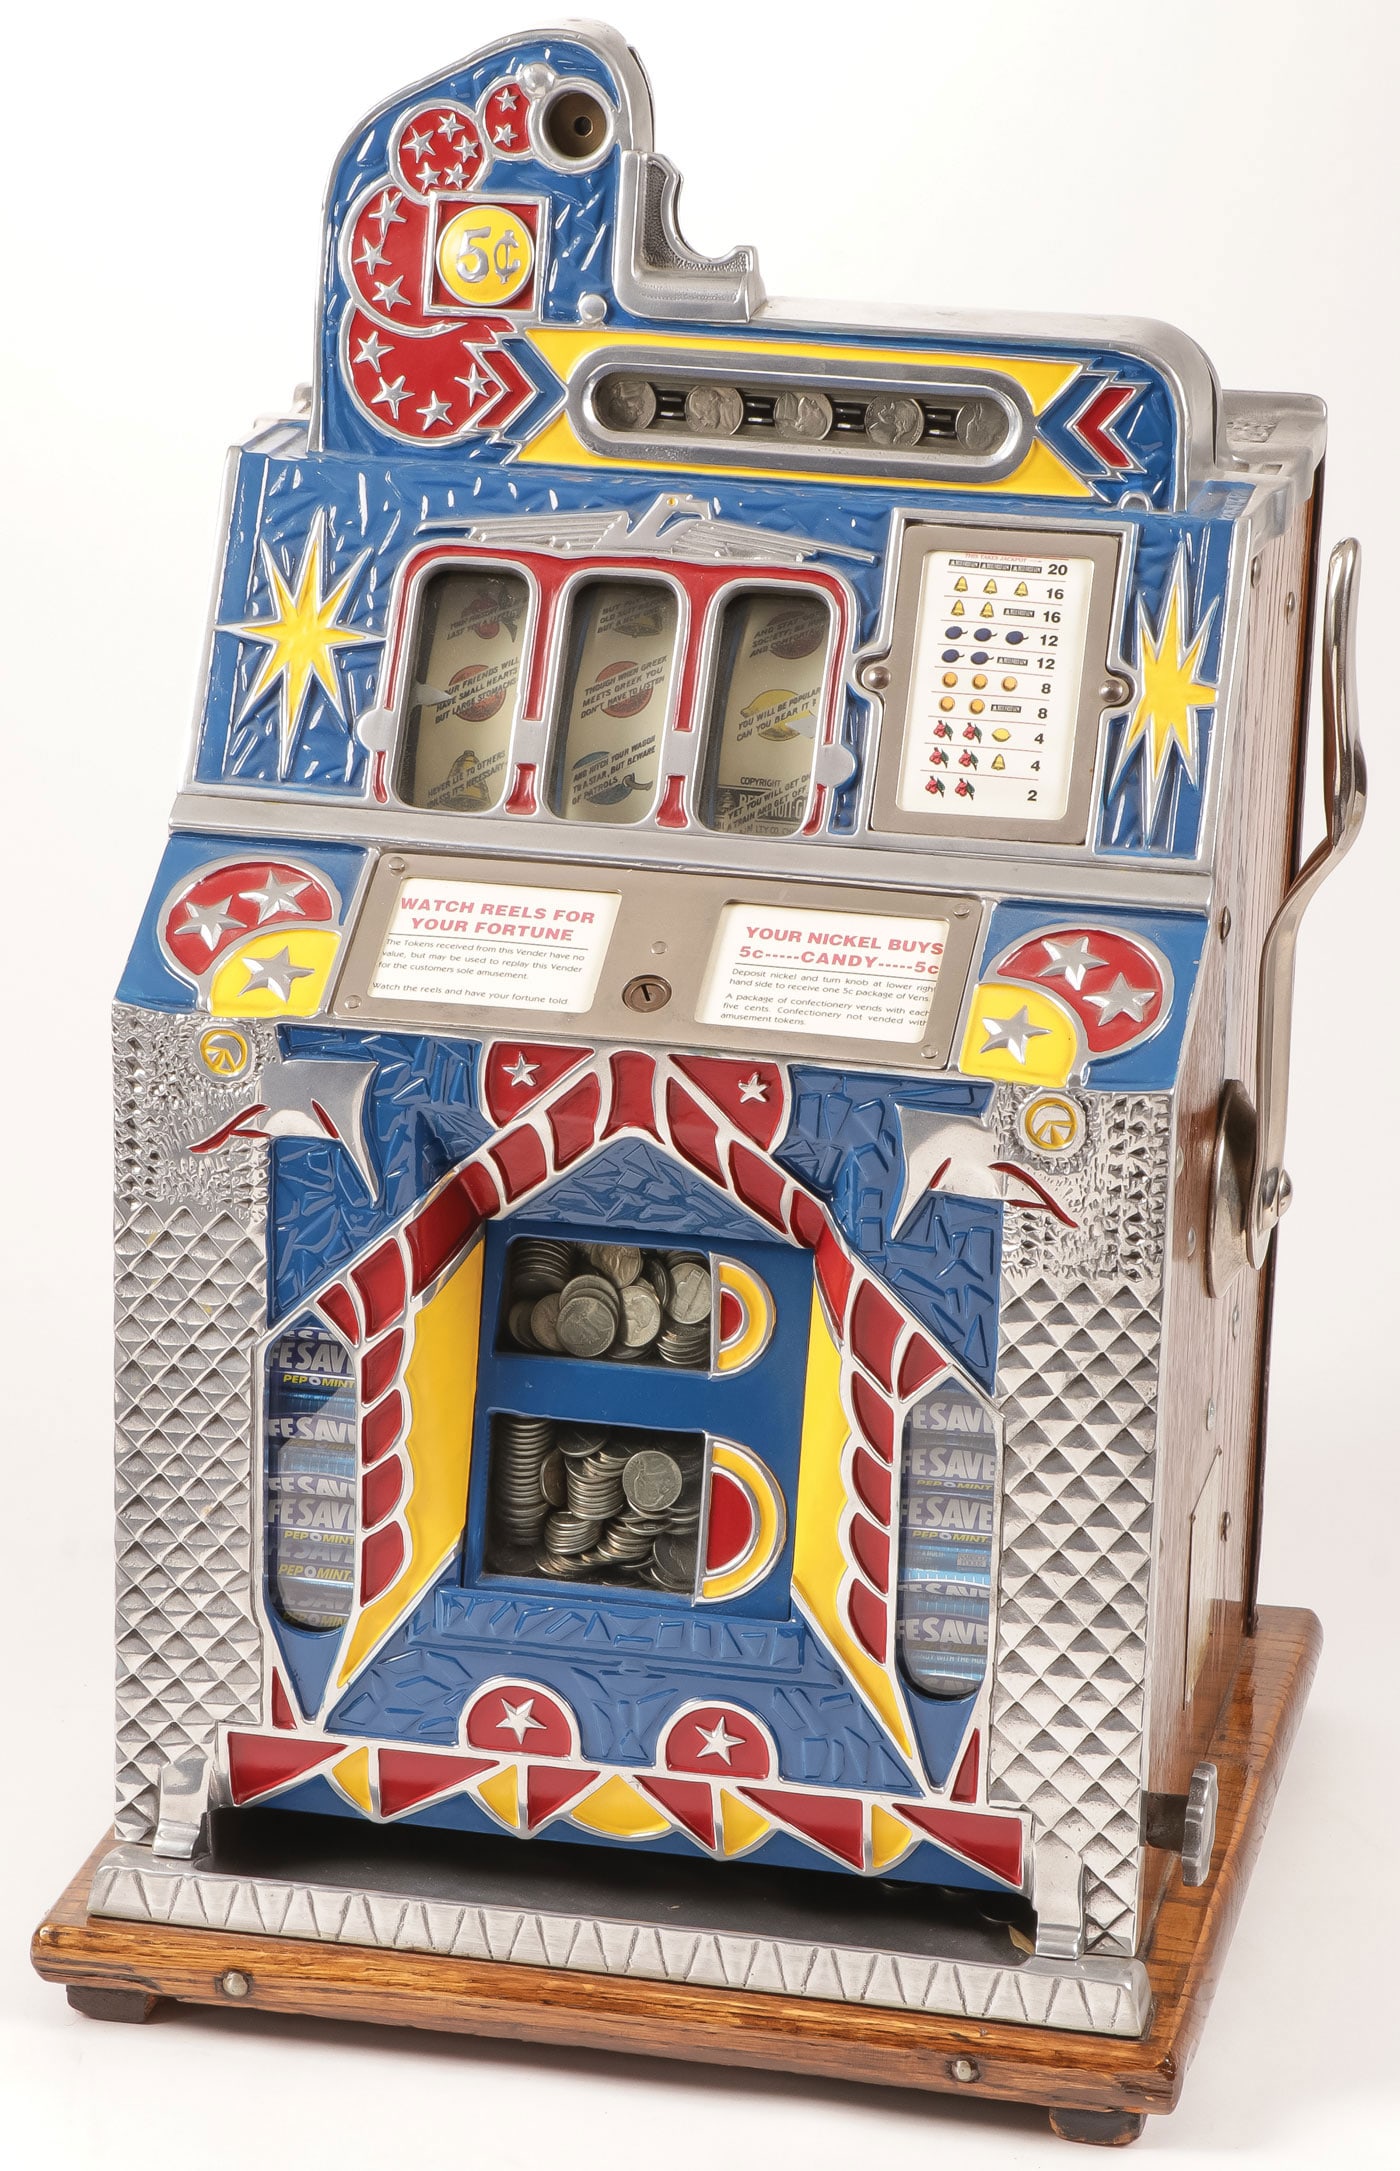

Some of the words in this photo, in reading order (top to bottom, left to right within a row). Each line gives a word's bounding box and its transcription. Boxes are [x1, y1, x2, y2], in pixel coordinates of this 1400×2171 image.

[456, 226, 521, 285] 5¢
[1047, 564, 1068, 576] 20
[1046, 588, 1065, 600] 16
[1042, 611, 1062, 623] 16
[754, 627, 774, 639] AND
[1040, 635, 1059, 647] 12
[749, 646, 769, 657] AND
[462, 666, 498, 689] FRIENDS
[501, 656, 520, 669] WILL
[1036, 658, 1056, 670] 12
[584, 677, 616, 696] THOUGH
[618, 667, 639, 681] WHEN
[640, 655, 668, 671] GREEK
[436, 696, 457, 712] HAVE
[458, 683, 484, 700] SMALL
[486, 667, 518, 687] HEARTS
[580, 702, 605, 719] DON'T
[608, 692, 627, 706] HAVE
[629, 687, 638, 697] TO
[639, 675, 665, 692] LISTEN
[582, 689, 611, 708] MEETS
[614, 675, 642, 692] GREEK
[646, 666, 663, 679] YOU
[1041, 683, 1052, 695] 8
[435, 710, 450, 724] BUT
[452, 697, 475, 716] LARGE
[738, 717, 754, 730] YOU
[756, 708, 776, 722] WILL
[777, 701, 788, 712] BE
[1037, 708, 1048, 719] 8
[736, 728, 753, 742] CAN
[756, 719, 772, 731] YOU
[774, 707, 798, 724] BEAR
[1034, 733, 1045, 745] 4
[466, 767, 476, 777] TO
[477, 749, 506, 771] OTHERS
[610, 761, 625, 774] BUT
[627, 744, 656, 766] BEWARE
[611, 747, 630, 762] YOUR
[1030, 760, 1041, 772] 4
[583, 777, 618, 799] PATROLS
[728, 807, 743, 819] YET
[747, 797, 762, 809] YOU
[764, 788, 783, 800] WILL
[784, 778, 798, 790] GET
[1027, 790, 1038, 801] 2
[774, 794, 790, 807] GET
[400, 897, 475, 914] WATCH
[480, 903, 547, 920] REELS
[553, 909, 596, 924] FOR
[411, 917, 469, 933] YOUR
[474, 922, 574, 942] FORTUNE
[386, 938, 401, 946] The
[404, 939, 434, 949] Tokens
[436, 942, 474, 951] received
[476, 945, 496, 953] from
[516, 948, 547, 958] Vender
[549, 952, 571, 960] have
[746, 926, 802, 943] YOUR
[807, 932, 882, 950] NICKEL
[888, 938, 944, 956] BUYS
[378, 961, 391, 969] for
[393, 962, 408, 970] the
[410, 964, 454, 973] customers
[456, 967, 475, 975] sole
[382, 950, 407, 959] value,
[410, 951, 426, 959] but
[429, 953, 447, 961] may
[450, 954, 461, 962] be
[502, 959, 530, 969] replay
[551, 963, 583, 973] Vender
[729, 978, 753, 986] hand
[754, 981, 773, 989] side
[787, 984, 820, 992] receive
[842, 987, 854, 995] 5c
[855, 990, 894, 1000] package
[732, 968, 767, 978] Deposit
[770, 972, 797, 980] nickel
[822, 976, 841, 984] turn
[845, 978, 869, 986] knob
[886, 981, 913, 990] lower
[372, 981, 401, 991] Watch
[403, 984, 418, 992] the
[420, 986, 442, 994] reels
[464, 989, 486, 998] have
[488, 992, 510, 1000] your
[512, 993, 546, 1003] fortune
[548, 997, 568, 1005] told
[723, 1002, 739, 1010] five
[777, 1006, 842, 1019] Confectionery
[846, 1013, 863, 1021] not
[868, 1015, 904, 1025] vended
[736, 994, 774, 1004] package
[790, 998, 853, 1010] confectionery
[856, 1004, 882, 1012] vends
[886, 1007, 906, 1015] with
[720, 1012, 772, 1023] amusement
